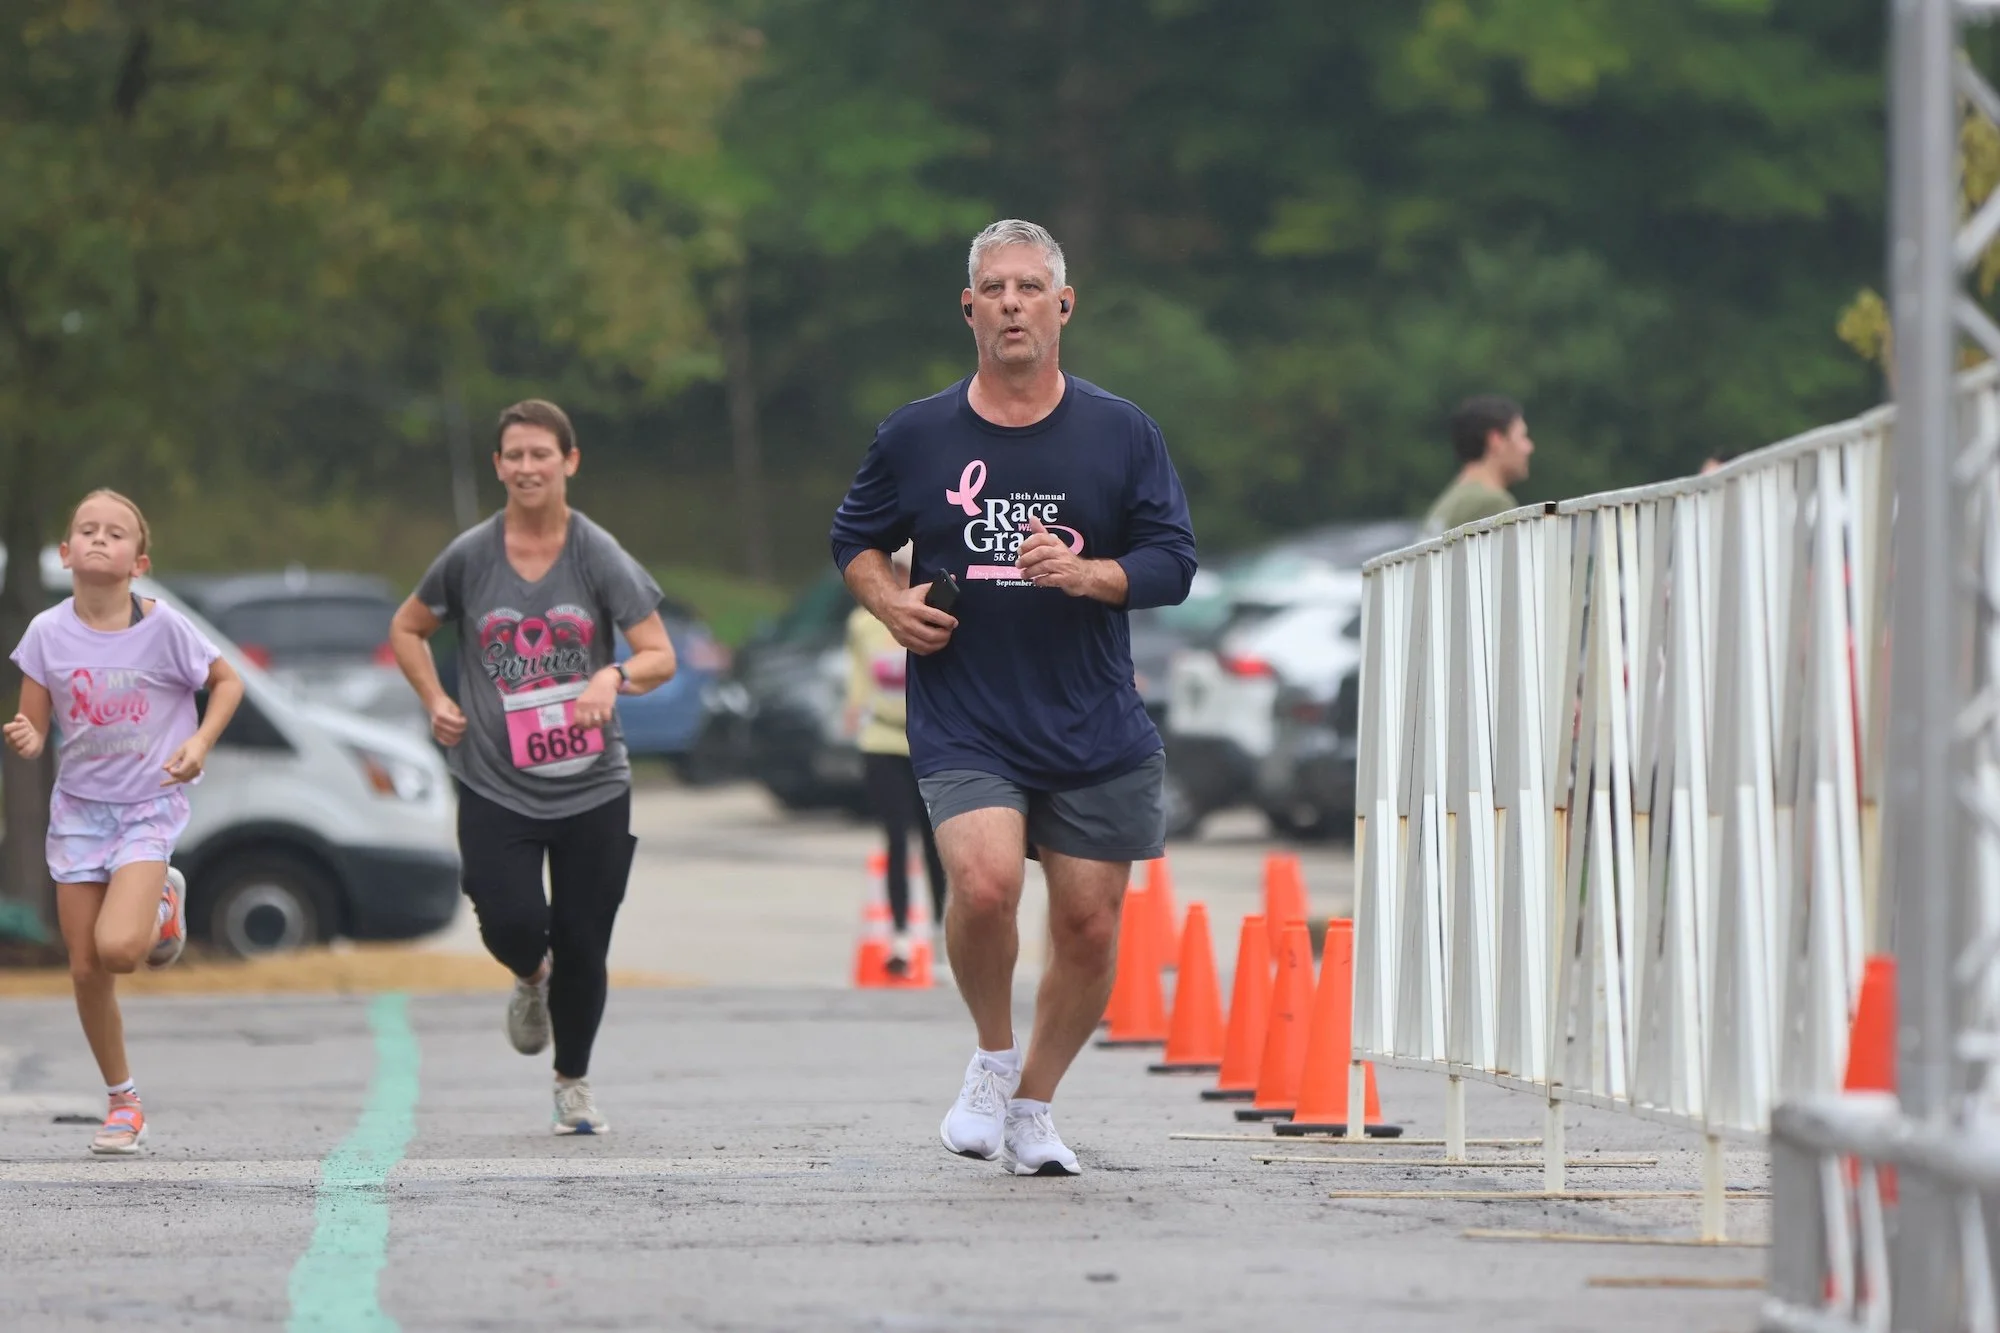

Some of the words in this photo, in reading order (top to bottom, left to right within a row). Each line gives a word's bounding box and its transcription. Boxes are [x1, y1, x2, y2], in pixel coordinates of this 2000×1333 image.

[1010, 492, 1031, 500] 18th
[1032, 492, 1066, 500] Annual
[984, 498, 1058, 531] Race
[1017, 523, 1032, 532] Wi
[963, 519, 1027, 553] Gra
[993, 553, 1006, 562] 5K
[1007, 553, 1016, 562] &
[996, 579, 1033, 588] September
[527, 724, 587, 763] 668
